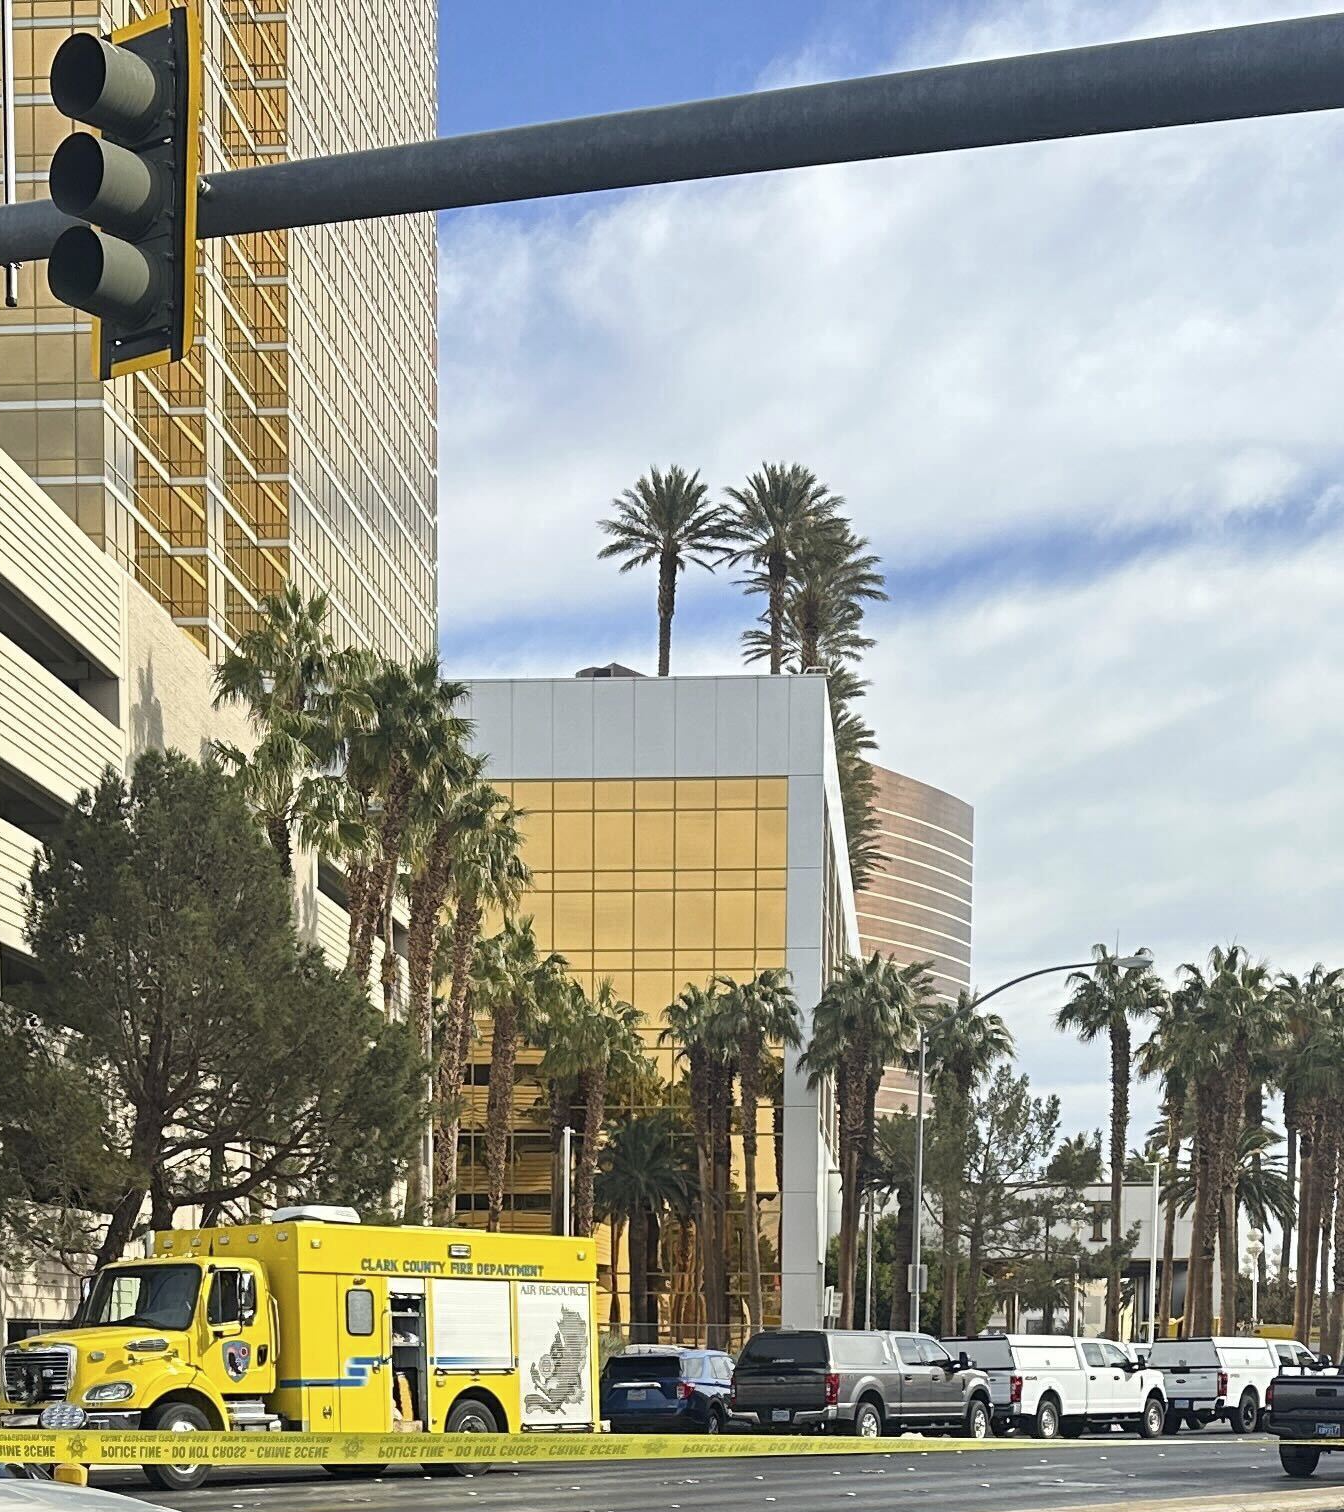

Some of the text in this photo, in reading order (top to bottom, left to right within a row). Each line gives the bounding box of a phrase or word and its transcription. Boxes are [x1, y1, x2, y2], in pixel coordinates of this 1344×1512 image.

[360, 1257, 545, 1278] CLARK COUNTY FIRE DEPARTMENT
[520, 1284, 588, 1297] AIR RESOURCE
